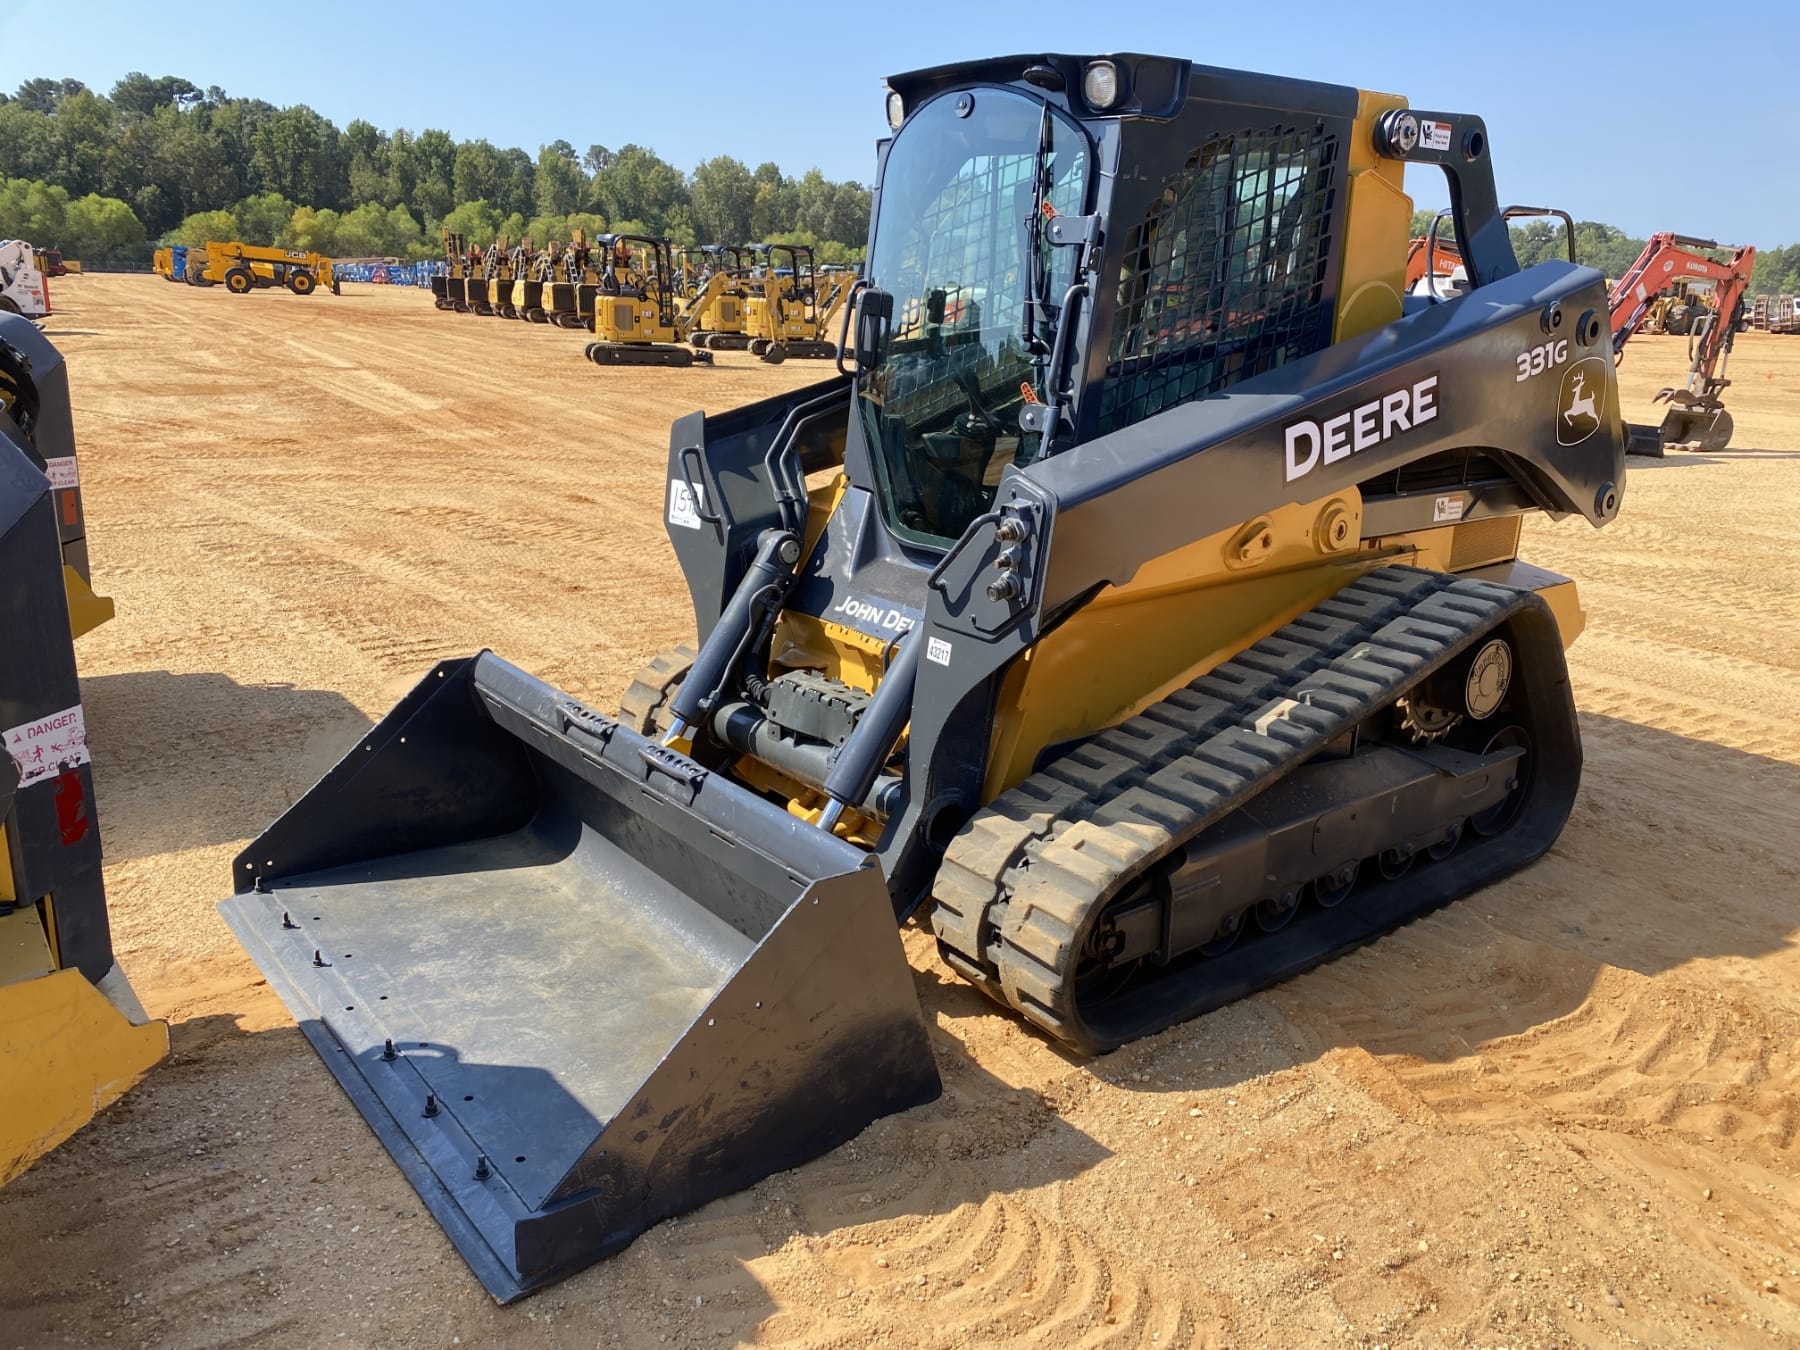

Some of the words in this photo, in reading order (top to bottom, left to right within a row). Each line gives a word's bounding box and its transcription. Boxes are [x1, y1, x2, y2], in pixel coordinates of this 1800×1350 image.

[285, 251, 306, 259] JCB
[1516, 339, 1568, 383] 331G
[1285, 375, 1438, 483] DEERE
[834, 595, 884, 624] JOHN
[929, 644, 949, 663] 43217
